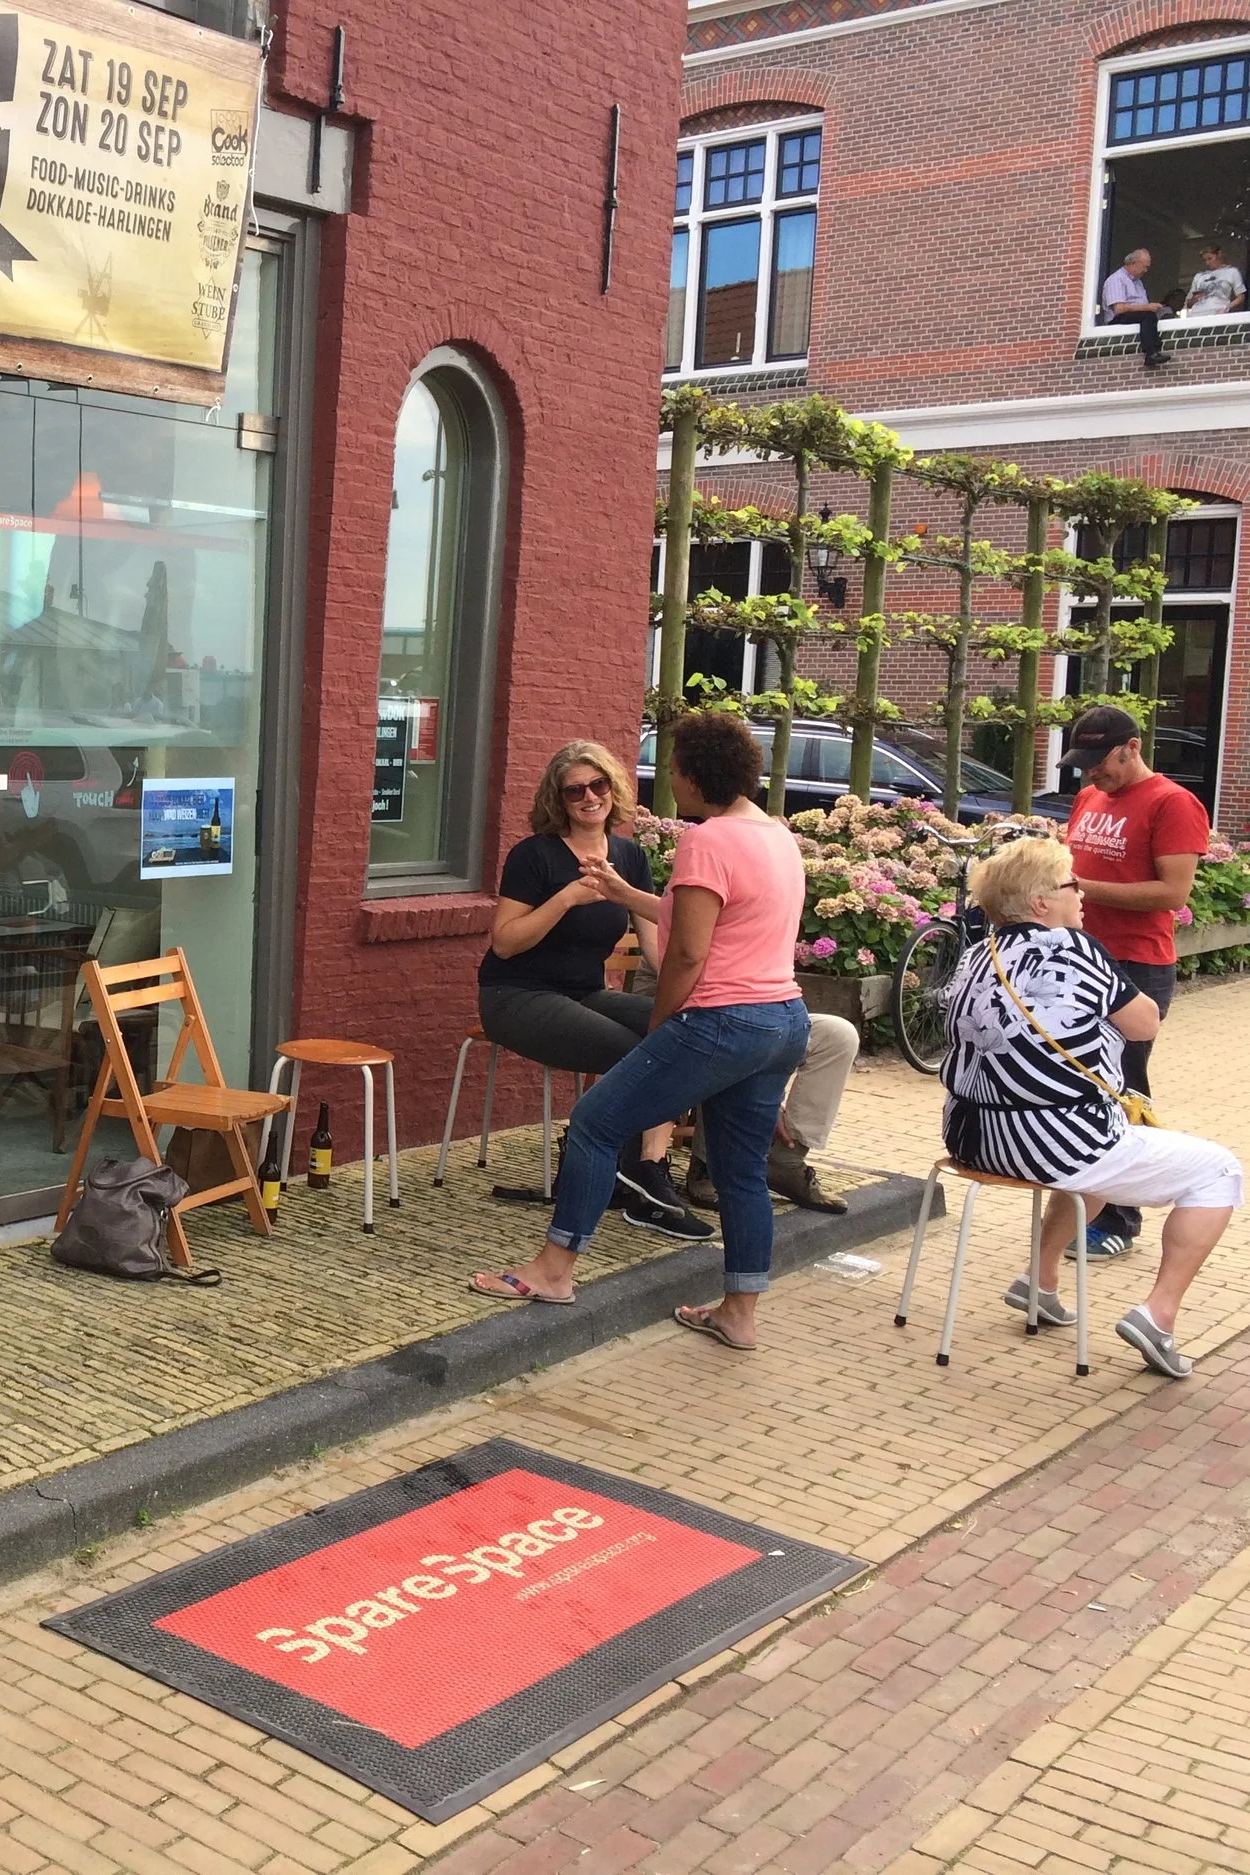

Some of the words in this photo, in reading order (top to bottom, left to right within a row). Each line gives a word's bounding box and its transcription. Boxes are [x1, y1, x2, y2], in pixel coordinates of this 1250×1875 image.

[42, 38, 93, 95] ZAT
[106, 59, 133, 107] 19
[141, 70, 188, 122] SEP
[36, 91, 89, 145] ZON
[99, 109, 129, 156] 20
[137, 120, 182, 168] SEP
[211, 125, 248, 156] Cook
[30, 155, 176, 213] FOOD-MUSIC-DRINKS
[26, 188, 172, 242] DOKKADE-HARLINGEN
[203, 194, 238, 222] Brand
[198, 282, 226, 301] WEIN
[191, 301, 226, 321] STUBE
[73, 790, 114, 808] TOUCH
[1075, 811, 1127, 837] RUM
[255, 1504, 606, 1666] SpareSpace
